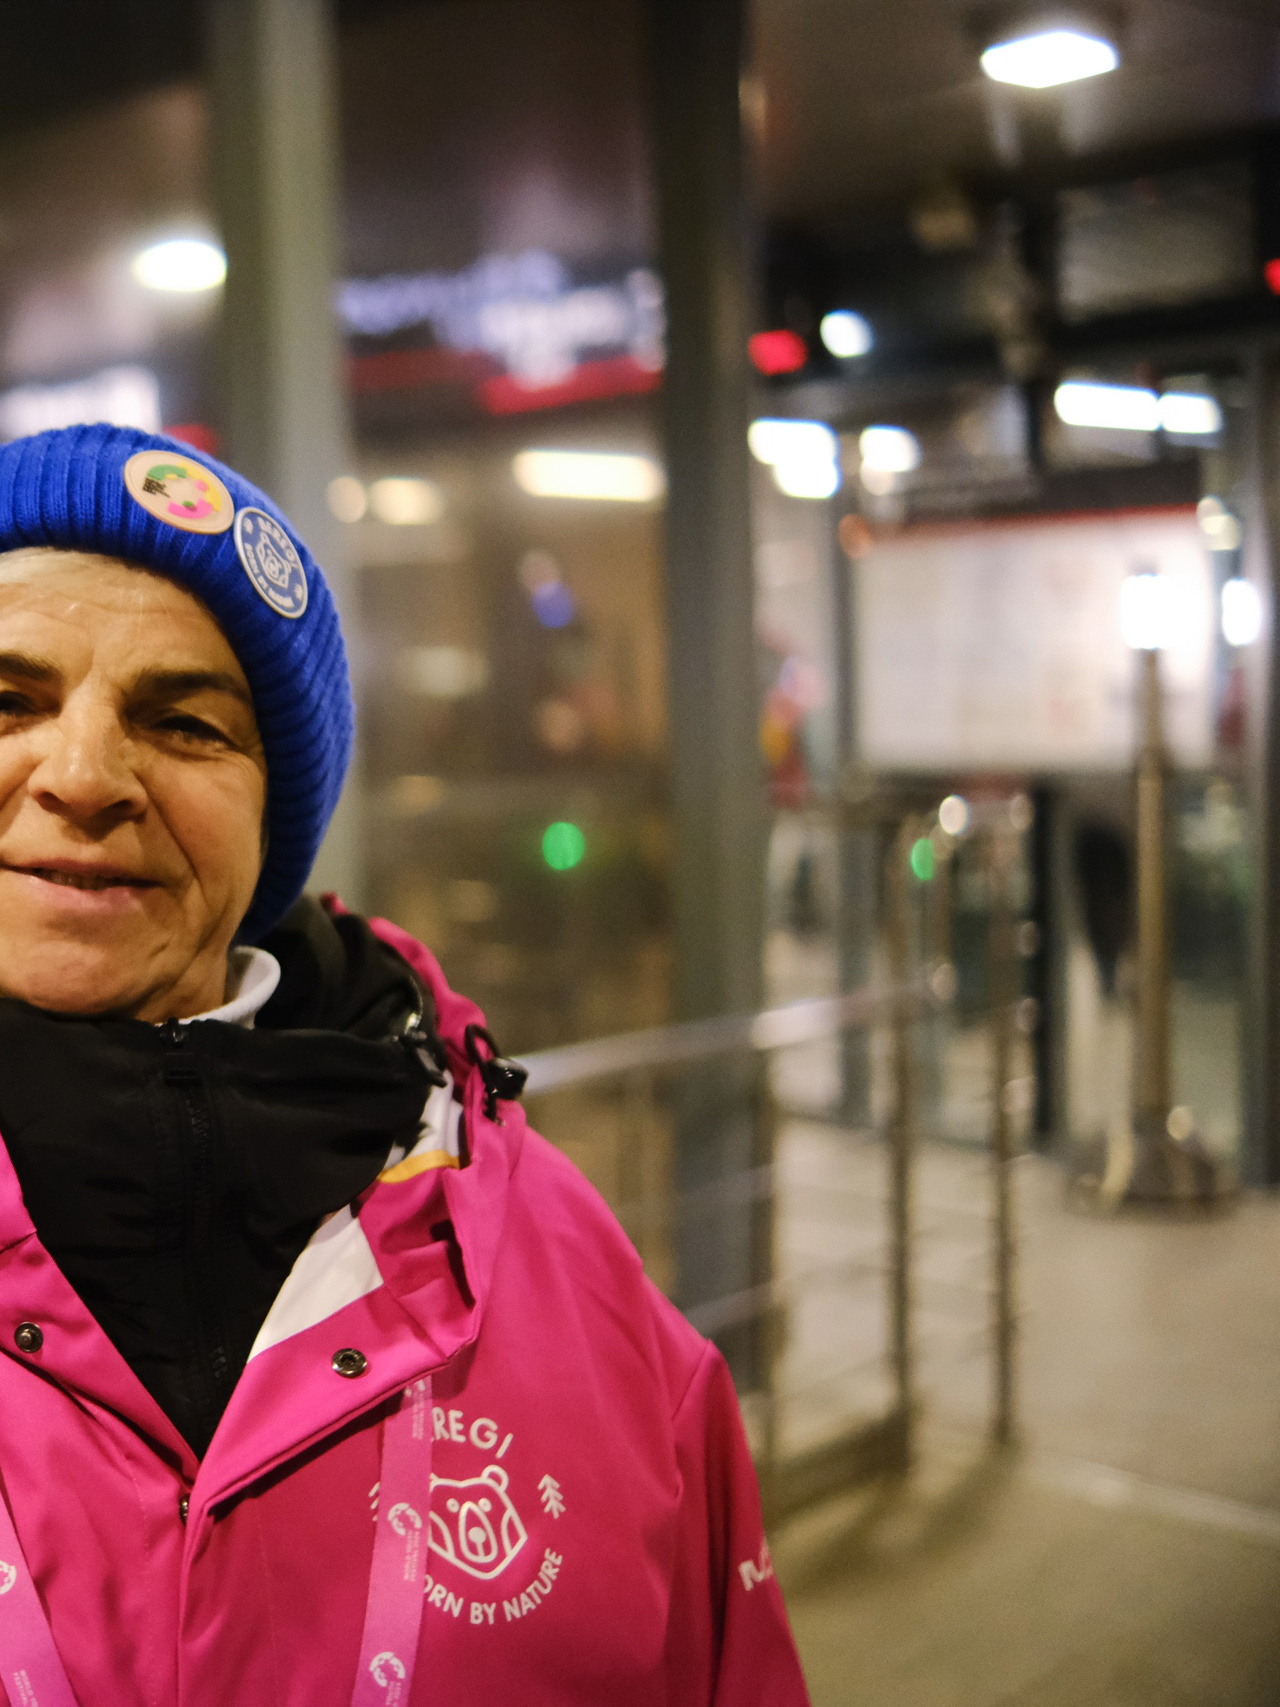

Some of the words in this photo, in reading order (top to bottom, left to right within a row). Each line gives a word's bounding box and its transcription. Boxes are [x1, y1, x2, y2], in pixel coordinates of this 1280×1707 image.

[431, 1405, 515, 1460] REGI
[469, 1601, 497, 1625] BY
[502, 1547, 563, 1622] NATURE
